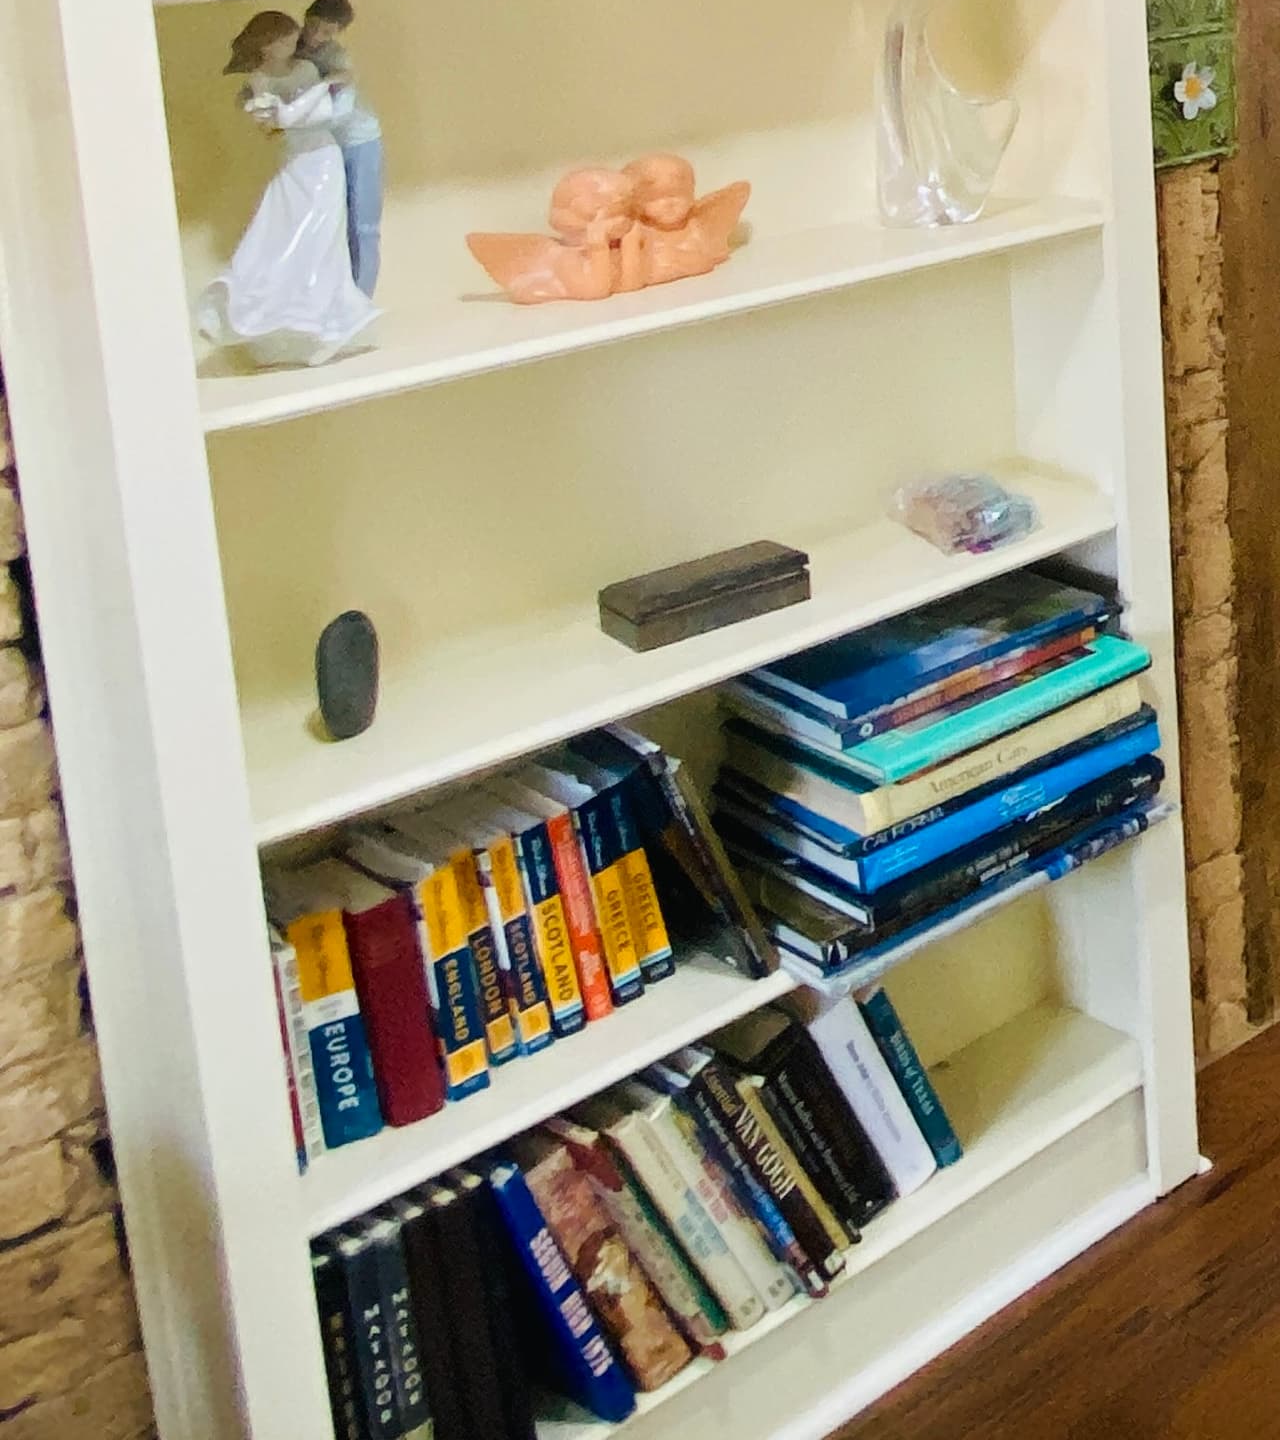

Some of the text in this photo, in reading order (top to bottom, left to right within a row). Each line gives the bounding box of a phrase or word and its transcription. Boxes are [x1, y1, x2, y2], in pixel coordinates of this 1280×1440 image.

[605, 888, 632, 953] GREECE
[632, 871, 659, 934] GREECE
[472, 934, 504, 1015] LONDON
[508, 921, 538, 1004] SCOTLAND
[541, 901, 574, 1002] SCOTLAND
[442, 958, 471, 1043] ENGLAND
[323, 1021, 361, 1112] EUROPE
[733, 1104, 762, 1150] VAN
[755, 1142, 798, 1201] GOGH
